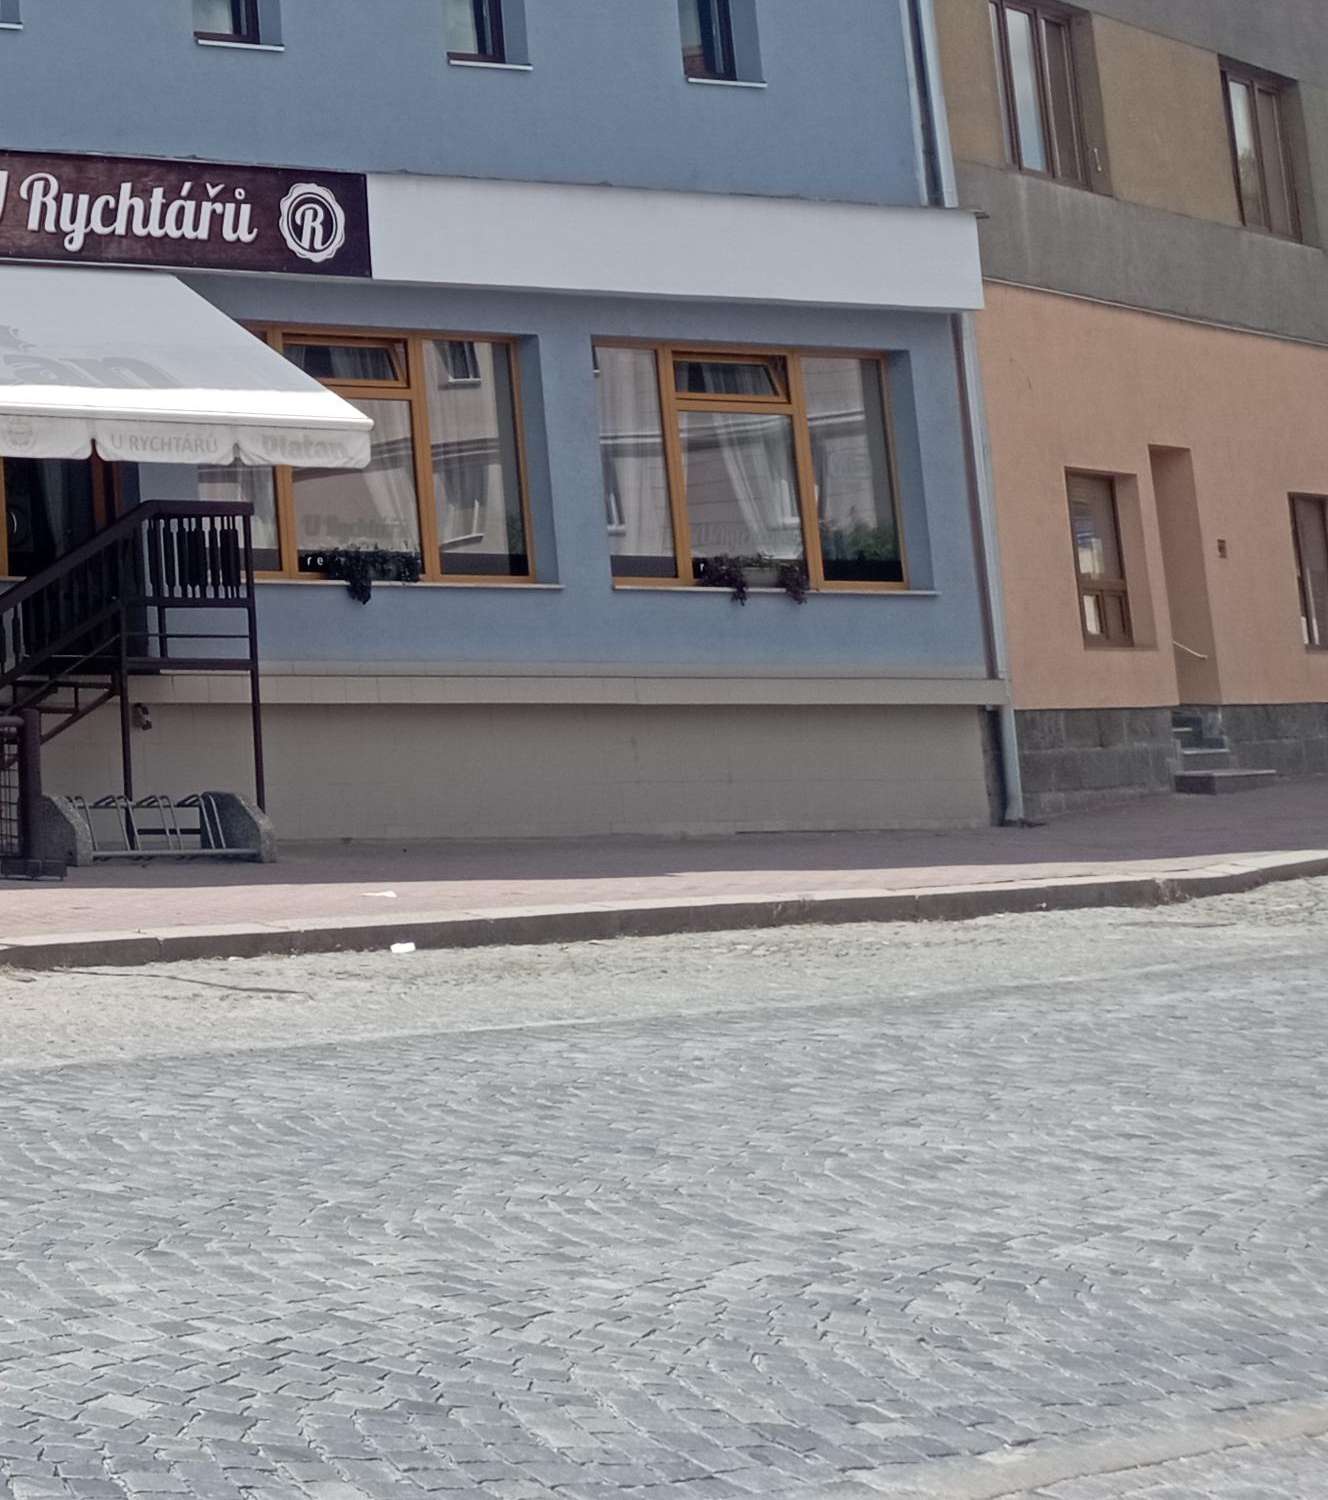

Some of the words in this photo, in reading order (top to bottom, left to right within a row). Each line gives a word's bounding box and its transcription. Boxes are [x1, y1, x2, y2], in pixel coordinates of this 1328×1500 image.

[19, 171, 258, 253] Rychtářů
[110, 434, 123, 450] U
[129, 432, 218, 453] RYCHTÁŘŮ
